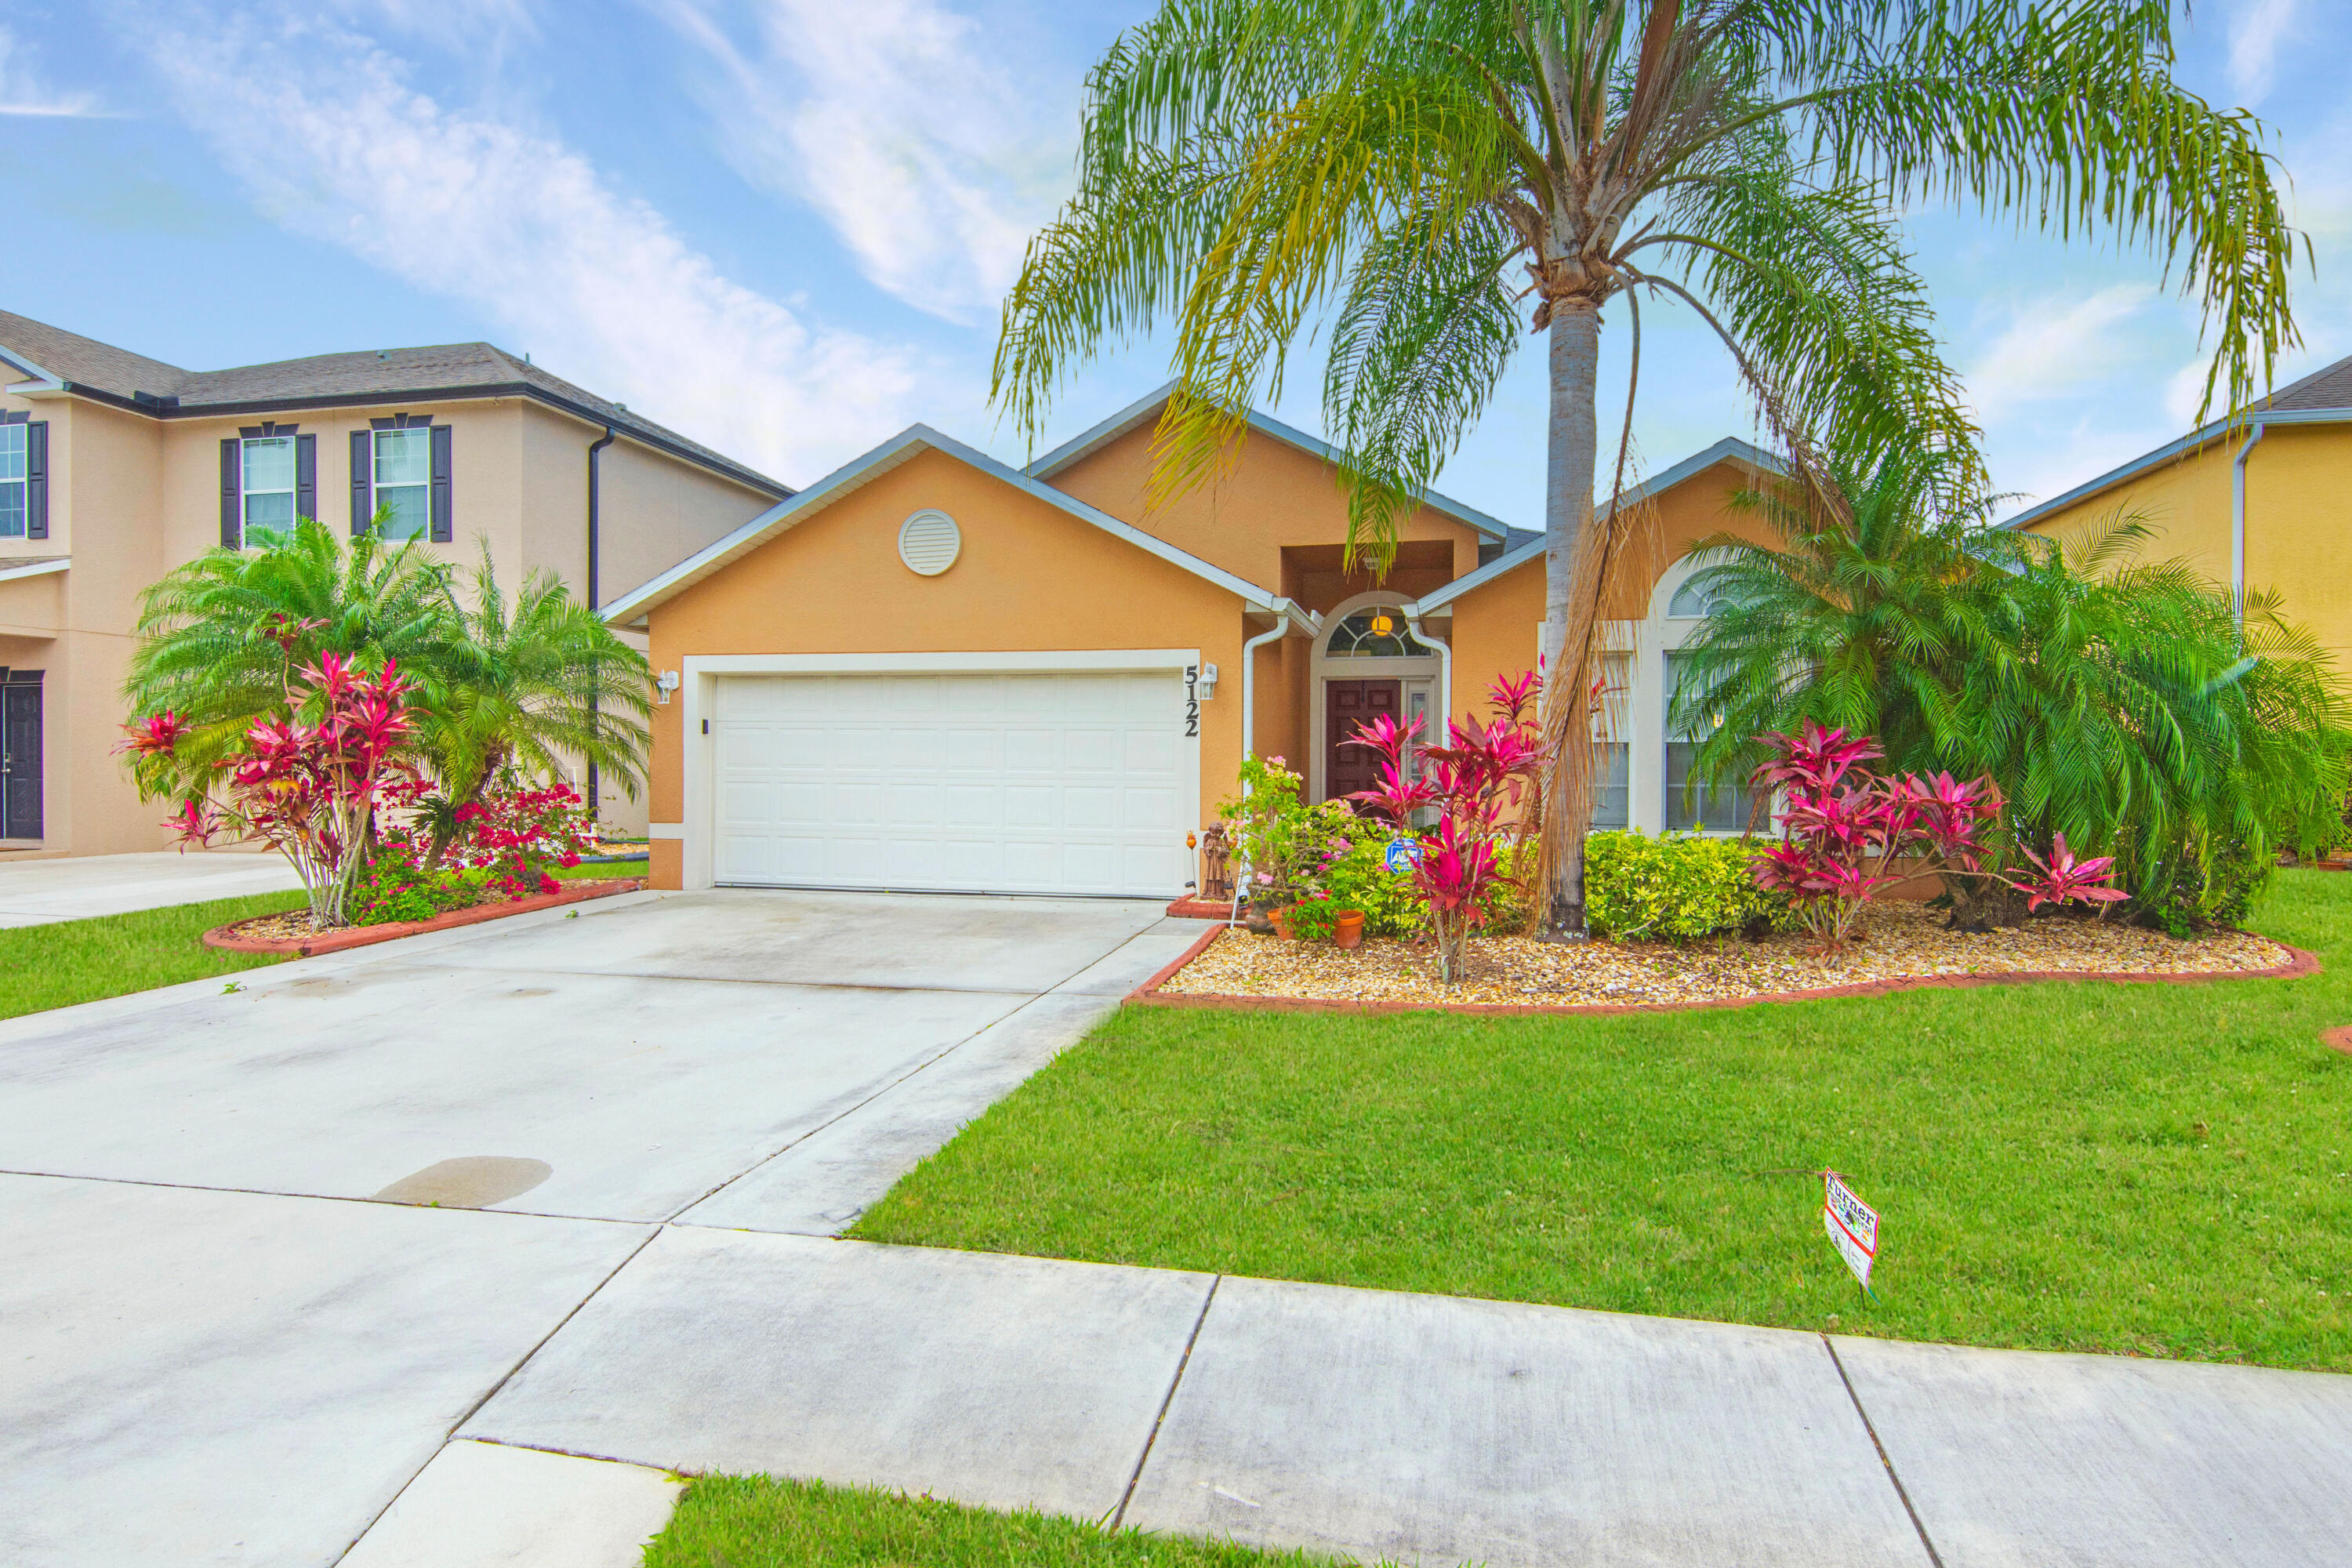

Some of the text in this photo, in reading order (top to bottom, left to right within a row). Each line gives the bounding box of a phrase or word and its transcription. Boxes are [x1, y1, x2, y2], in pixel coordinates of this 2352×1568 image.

[1185, 665, 1200, 737] 5122
[1827, 1172, 1875, 1225] Turner
[1843, 1203, 1873, 1236] Cntrol
